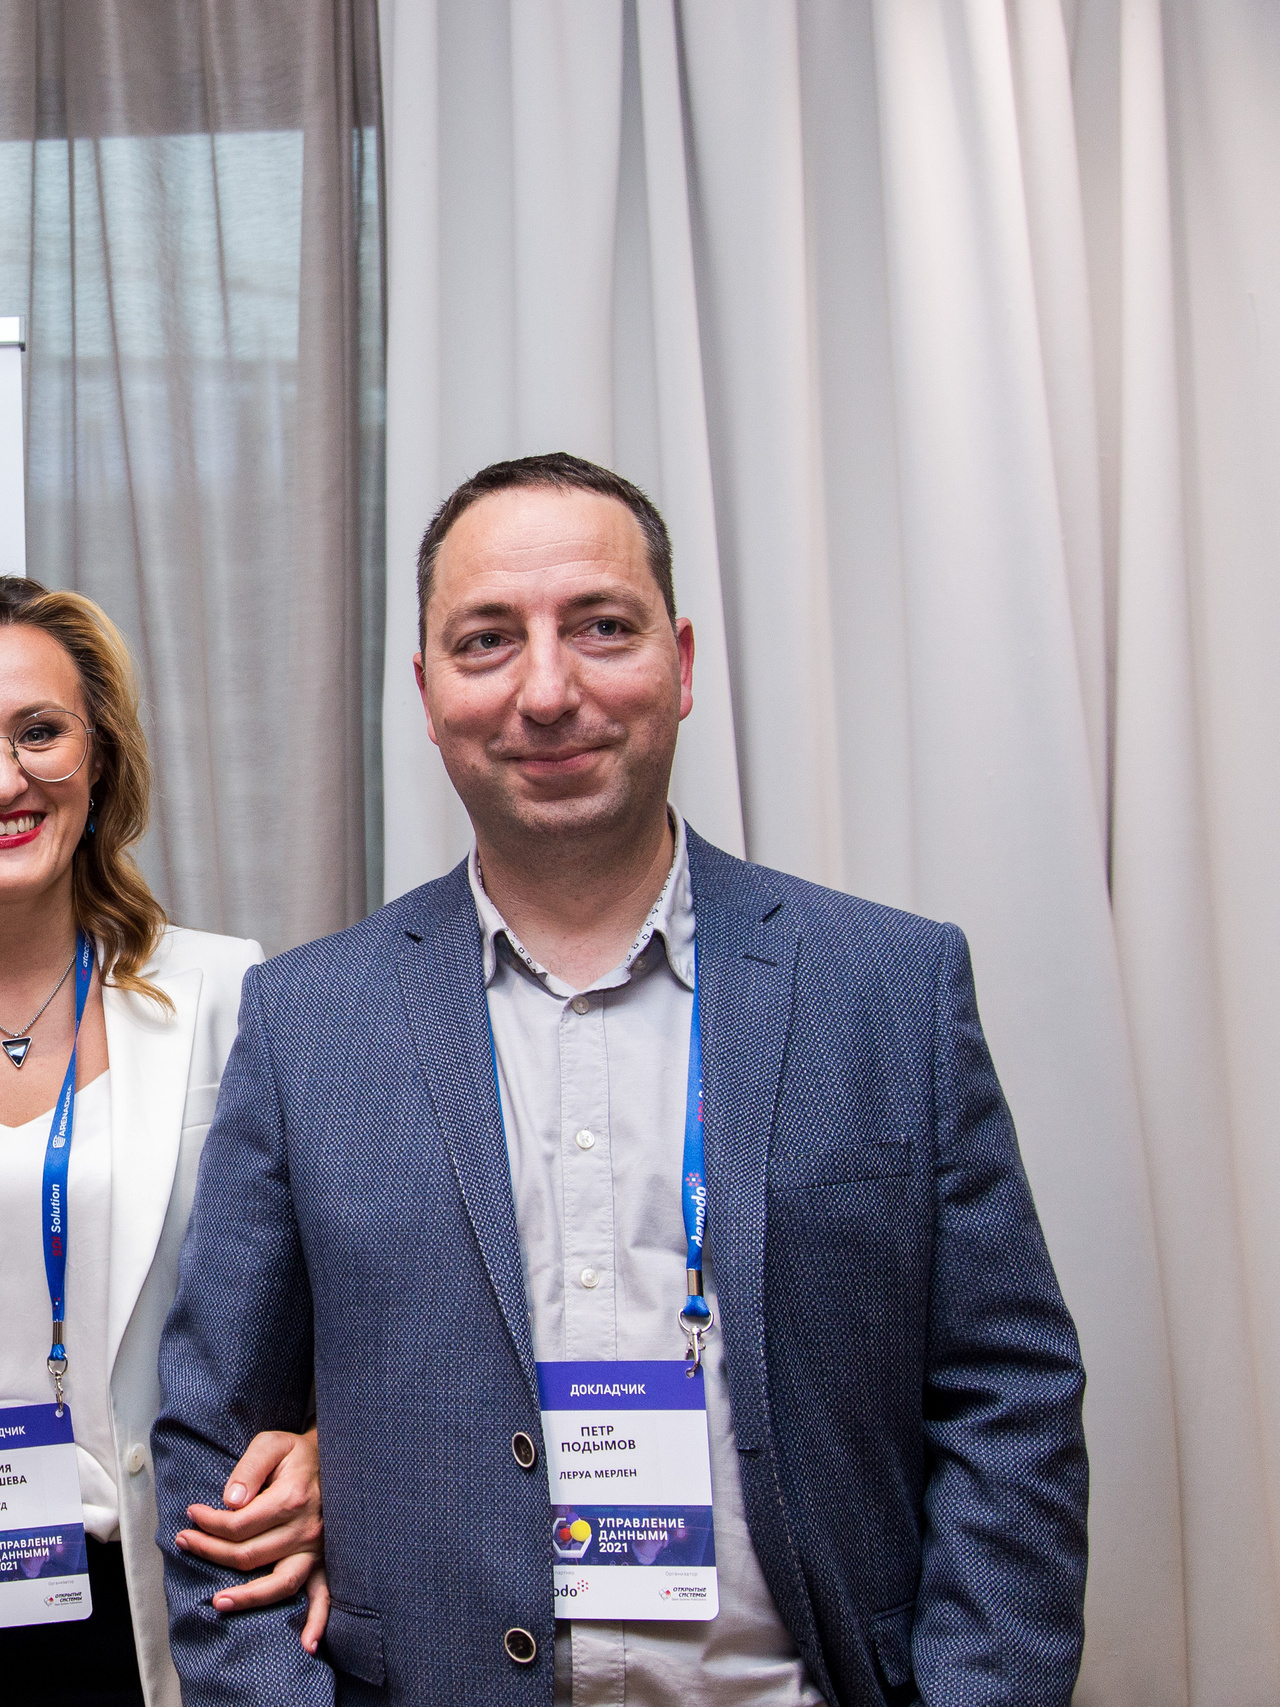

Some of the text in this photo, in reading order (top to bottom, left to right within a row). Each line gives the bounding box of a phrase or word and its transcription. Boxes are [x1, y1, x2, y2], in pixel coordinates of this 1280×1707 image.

[59, 1084, 73, 1137] ARENADATA
[50, 1184, 62, 1257] SDI Solution
[570, 1384, 646, 1397] ДОКЛАДЧИК
[580, 1425, 614, 1437] ПЕТР
[561, 1439, 636, 1454] ПОДЫМОВ
[559, 1469, 637, 1480] ЛЕРУА МЕРЛЕН
[598, 1518, 685, 1529] УПРАВЛЕНИЕ
[598, 1530, 668, 1543] ДАННЫМИ
[599, 1542, 628, 1553] 2021
